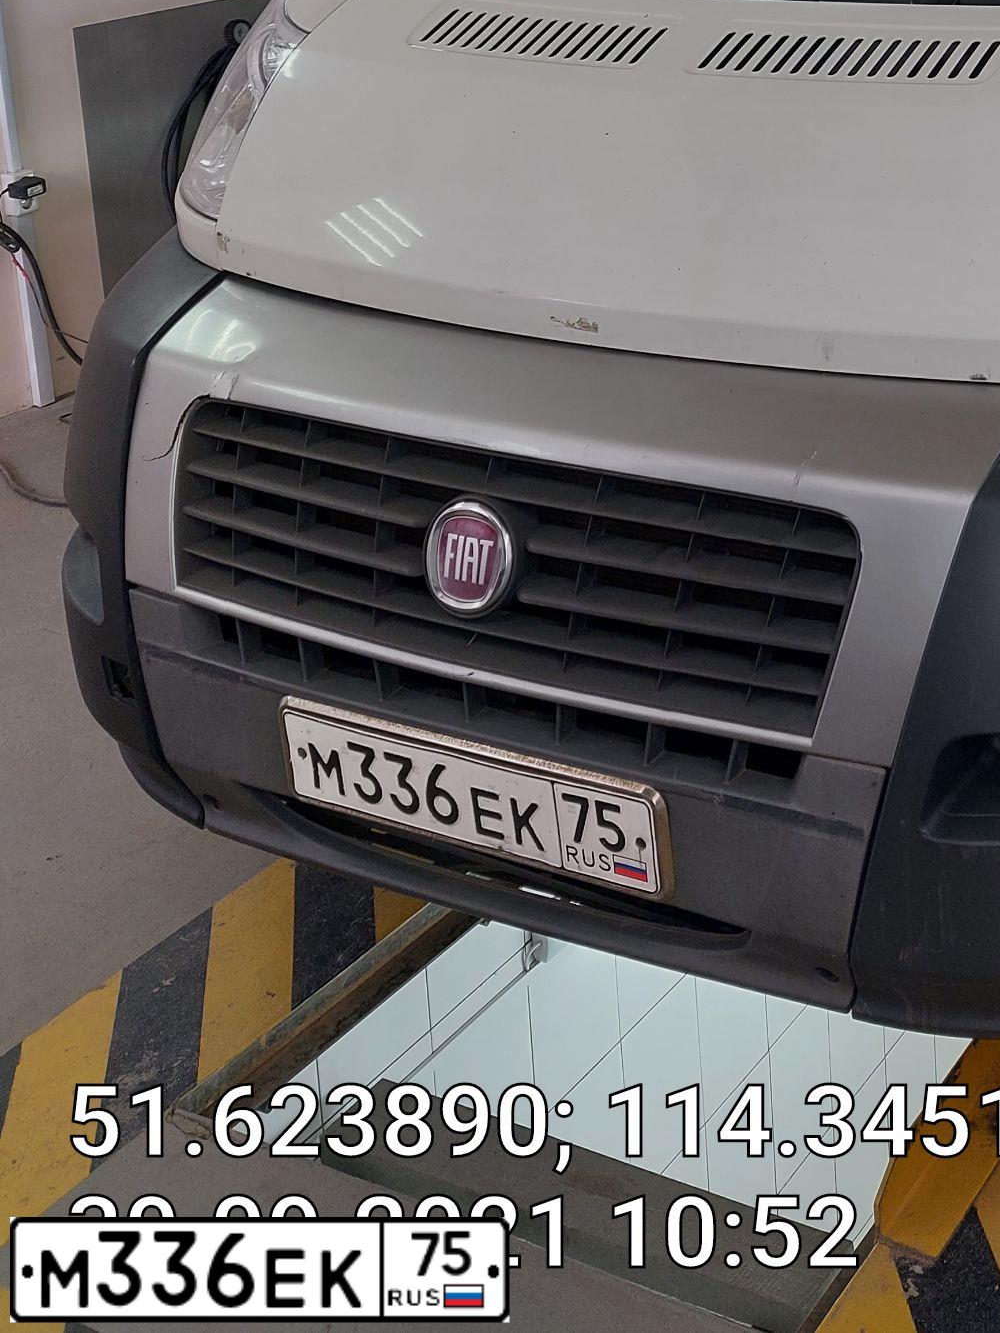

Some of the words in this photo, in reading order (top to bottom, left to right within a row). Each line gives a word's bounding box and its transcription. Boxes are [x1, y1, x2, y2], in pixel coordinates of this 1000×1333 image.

[443, 532, 495, 586] FIAT
[561, 792, 626, 853] 75
[565, 844, 613, 872] RUS
